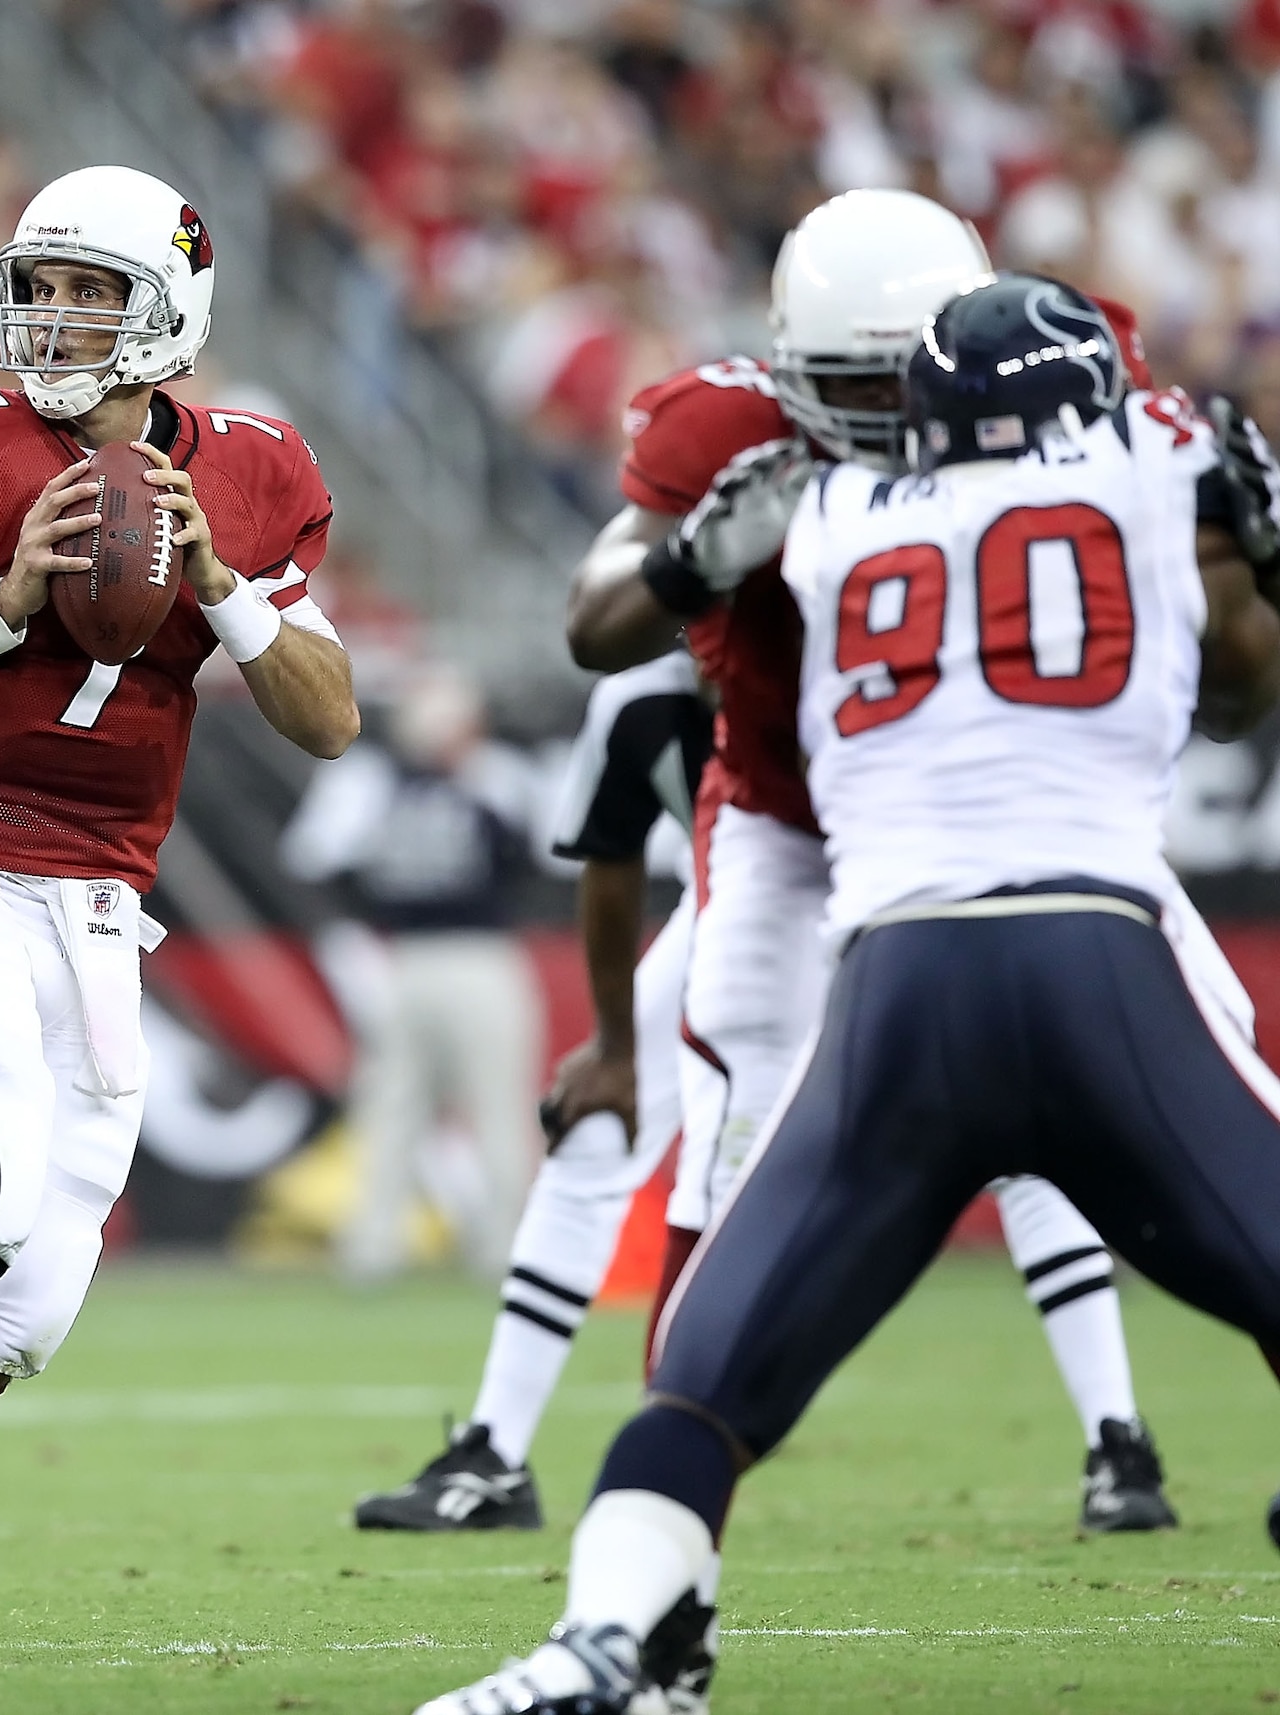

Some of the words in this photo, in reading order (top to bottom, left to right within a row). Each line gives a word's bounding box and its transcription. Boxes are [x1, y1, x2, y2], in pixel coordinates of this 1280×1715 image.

[207, 411, 284, 442] 7
[825, 502, 1134, 738] 90
[87, 922, 122, 936] Wilson
